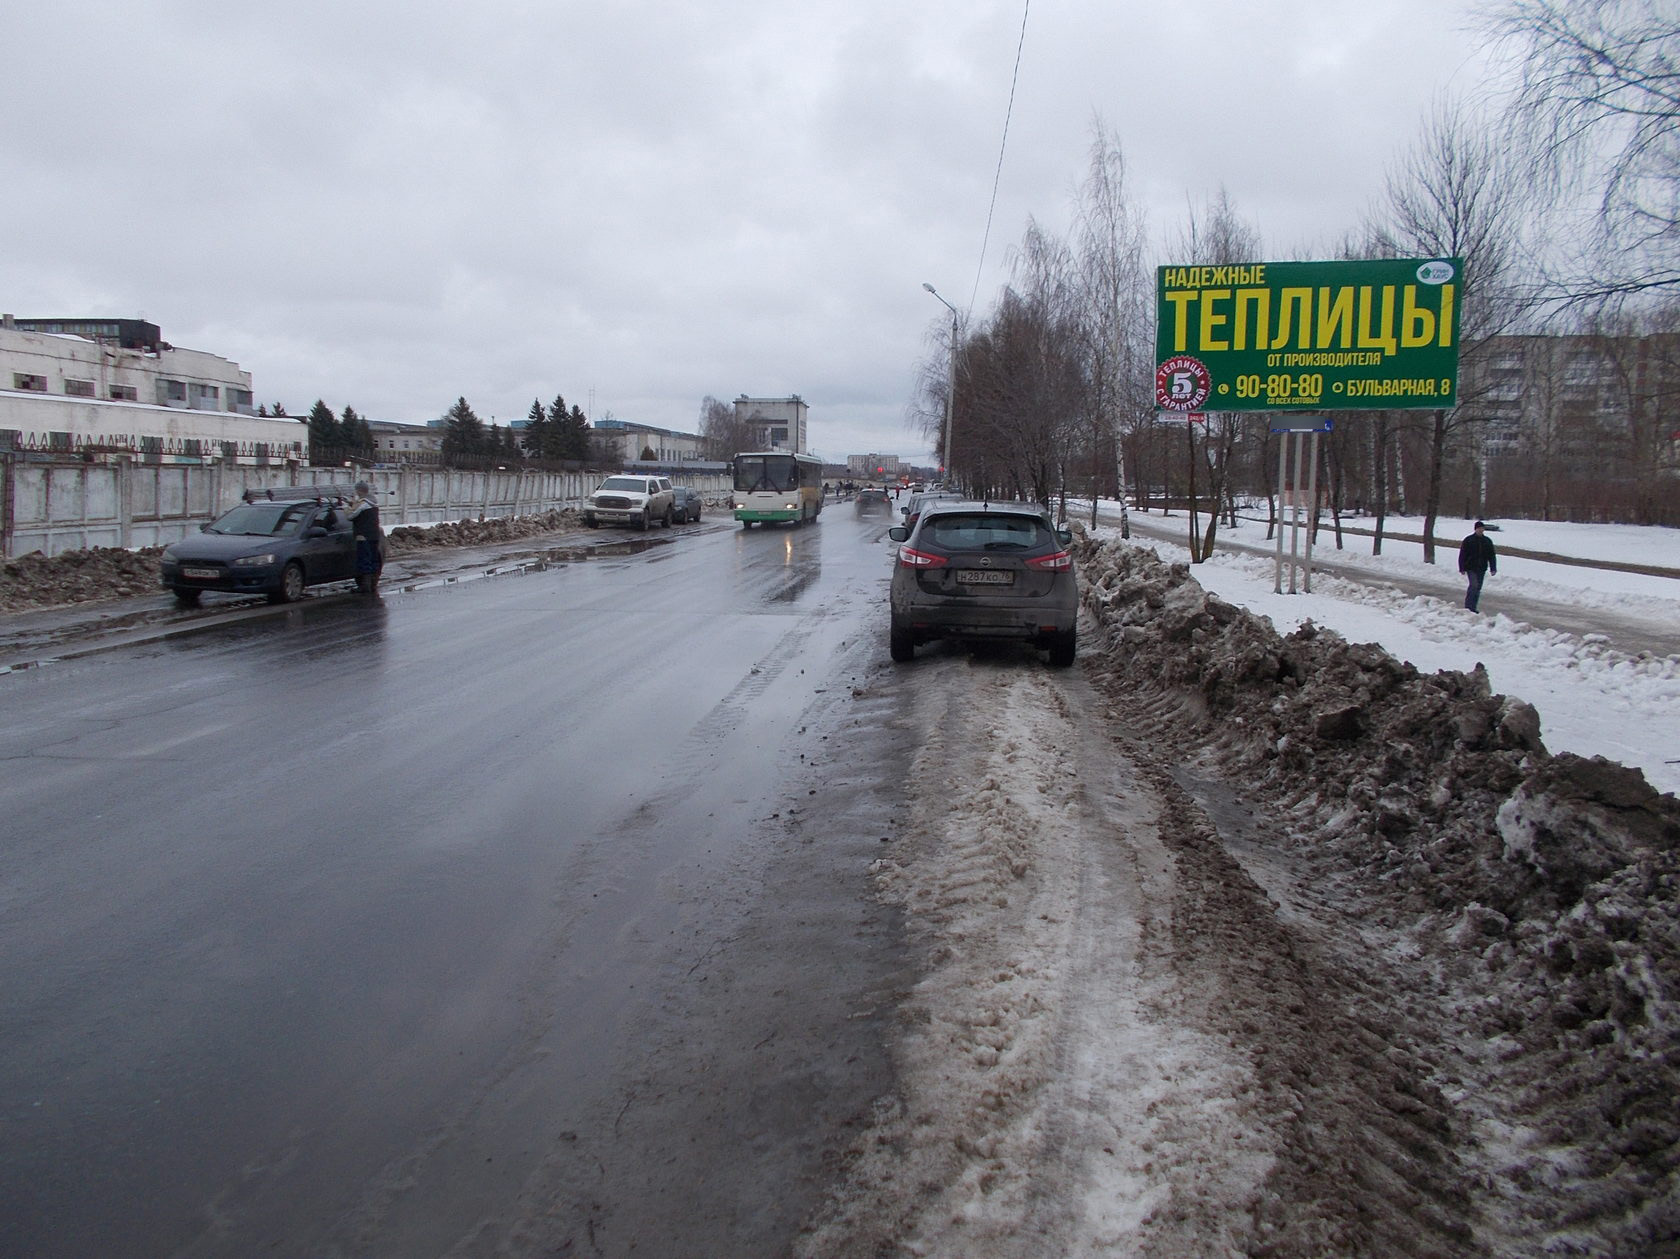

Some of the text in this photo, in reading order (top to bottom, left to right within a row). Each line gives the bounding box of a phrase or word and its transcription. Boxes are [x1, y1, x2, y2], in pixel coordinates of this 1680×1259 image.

[1165, 265, 1265, 288] НАДЕЖНЫЕ
[1165, 286, 1454, 356] ТЕПЛИЦЫ
[1159, 360, 1204, 378] ТЕПЛИЦЫ
[1267, 352, 1381, 367] ОТ ПРОИЗВОДИТЕЛЯ
[1172, 372, 1192, 394] 5
[1236, 374, 1323, 398] 90-80-80
[1347, 379, 1450, 397] БУЛЬВАРНАЯ, 8
[1160, 388, 1207, 411] ГАРАНТИЕЙ
